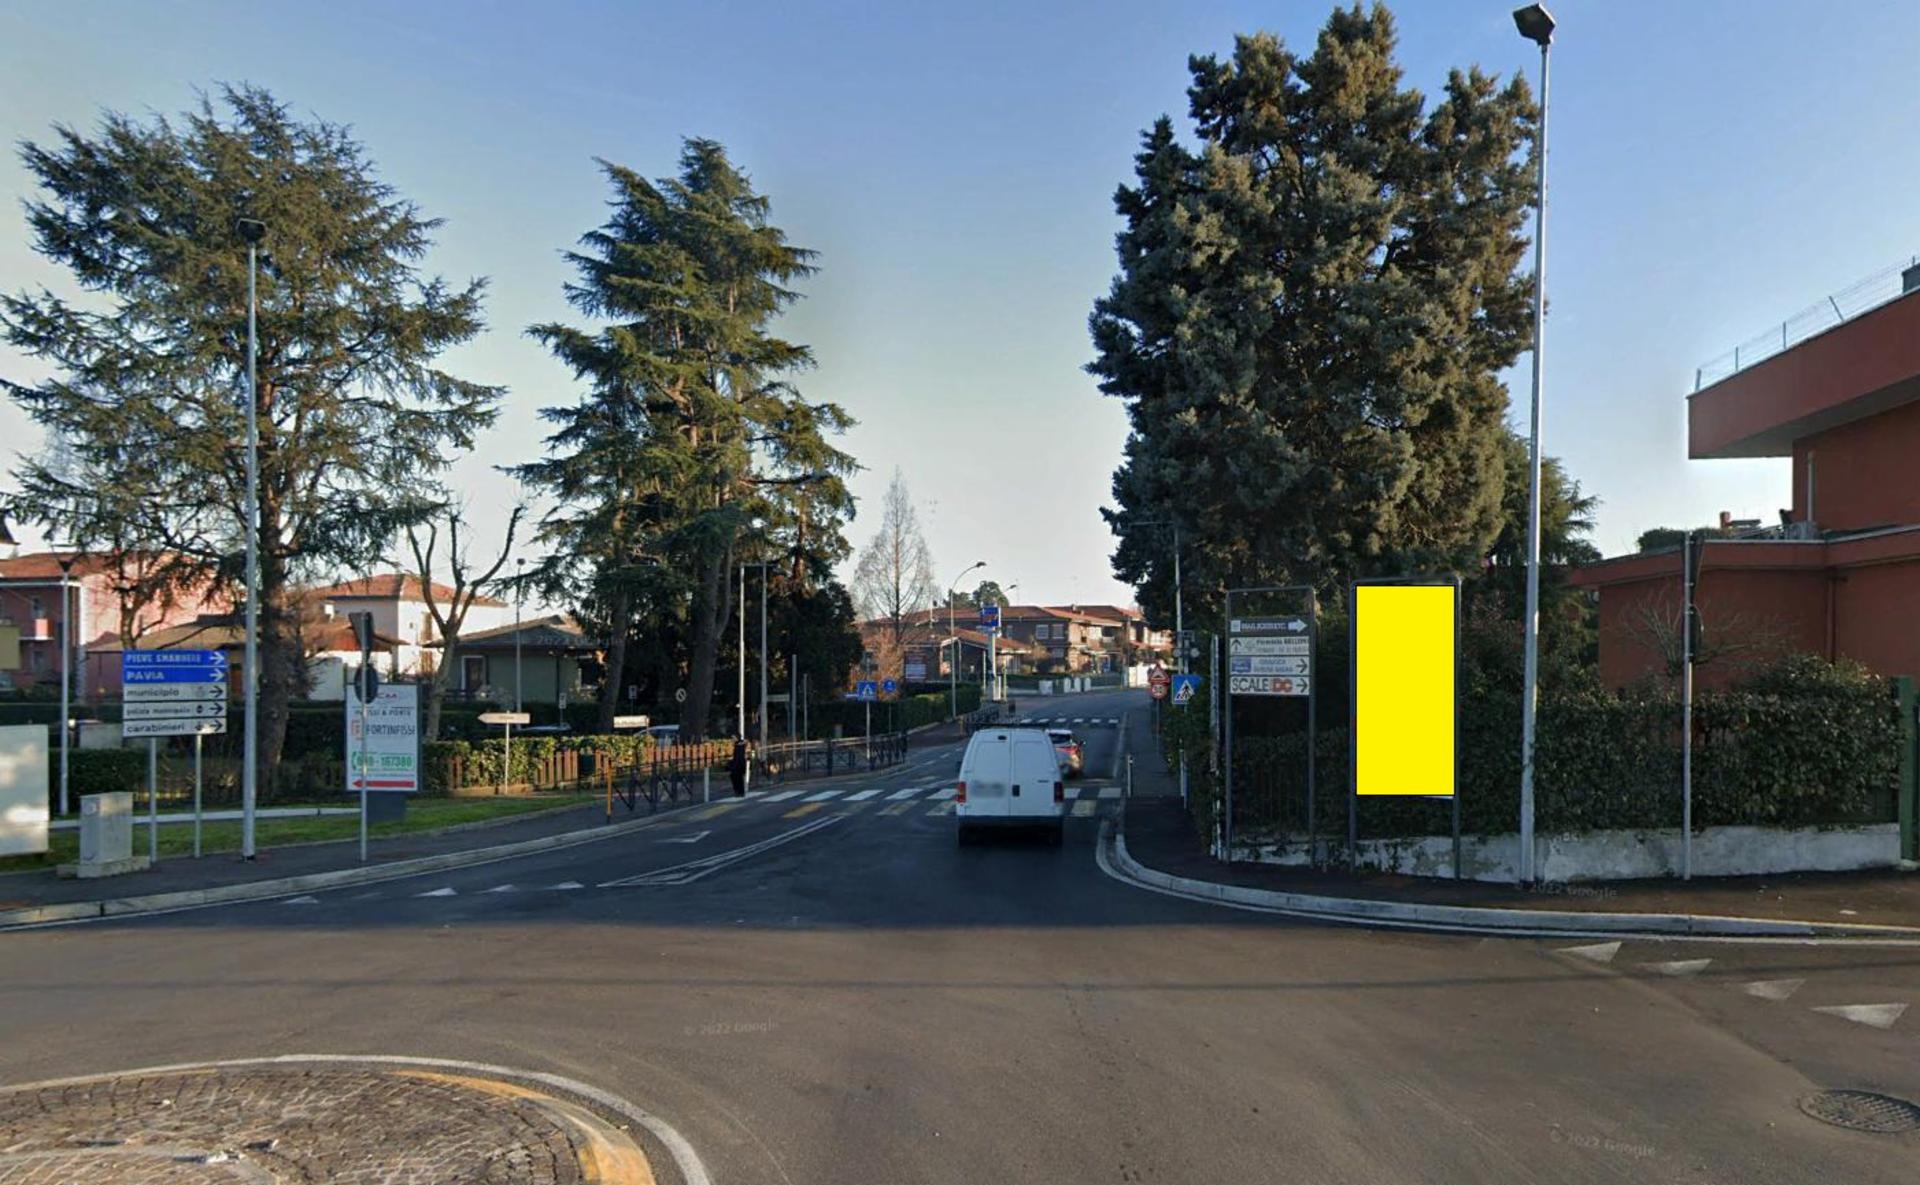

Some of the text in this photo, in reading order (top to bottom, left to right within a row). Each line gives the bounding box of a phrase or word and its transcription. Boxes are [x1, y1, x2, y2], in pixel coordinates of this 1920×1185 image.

[126, 654, 153, 663] PIEVE
[126, 671, 165, 680] PAVIA
[1232, 678, 1269, 692] SCALE
[127, 688, 180, 698] municipio
[127, 723, 185, 734] carabinieri
